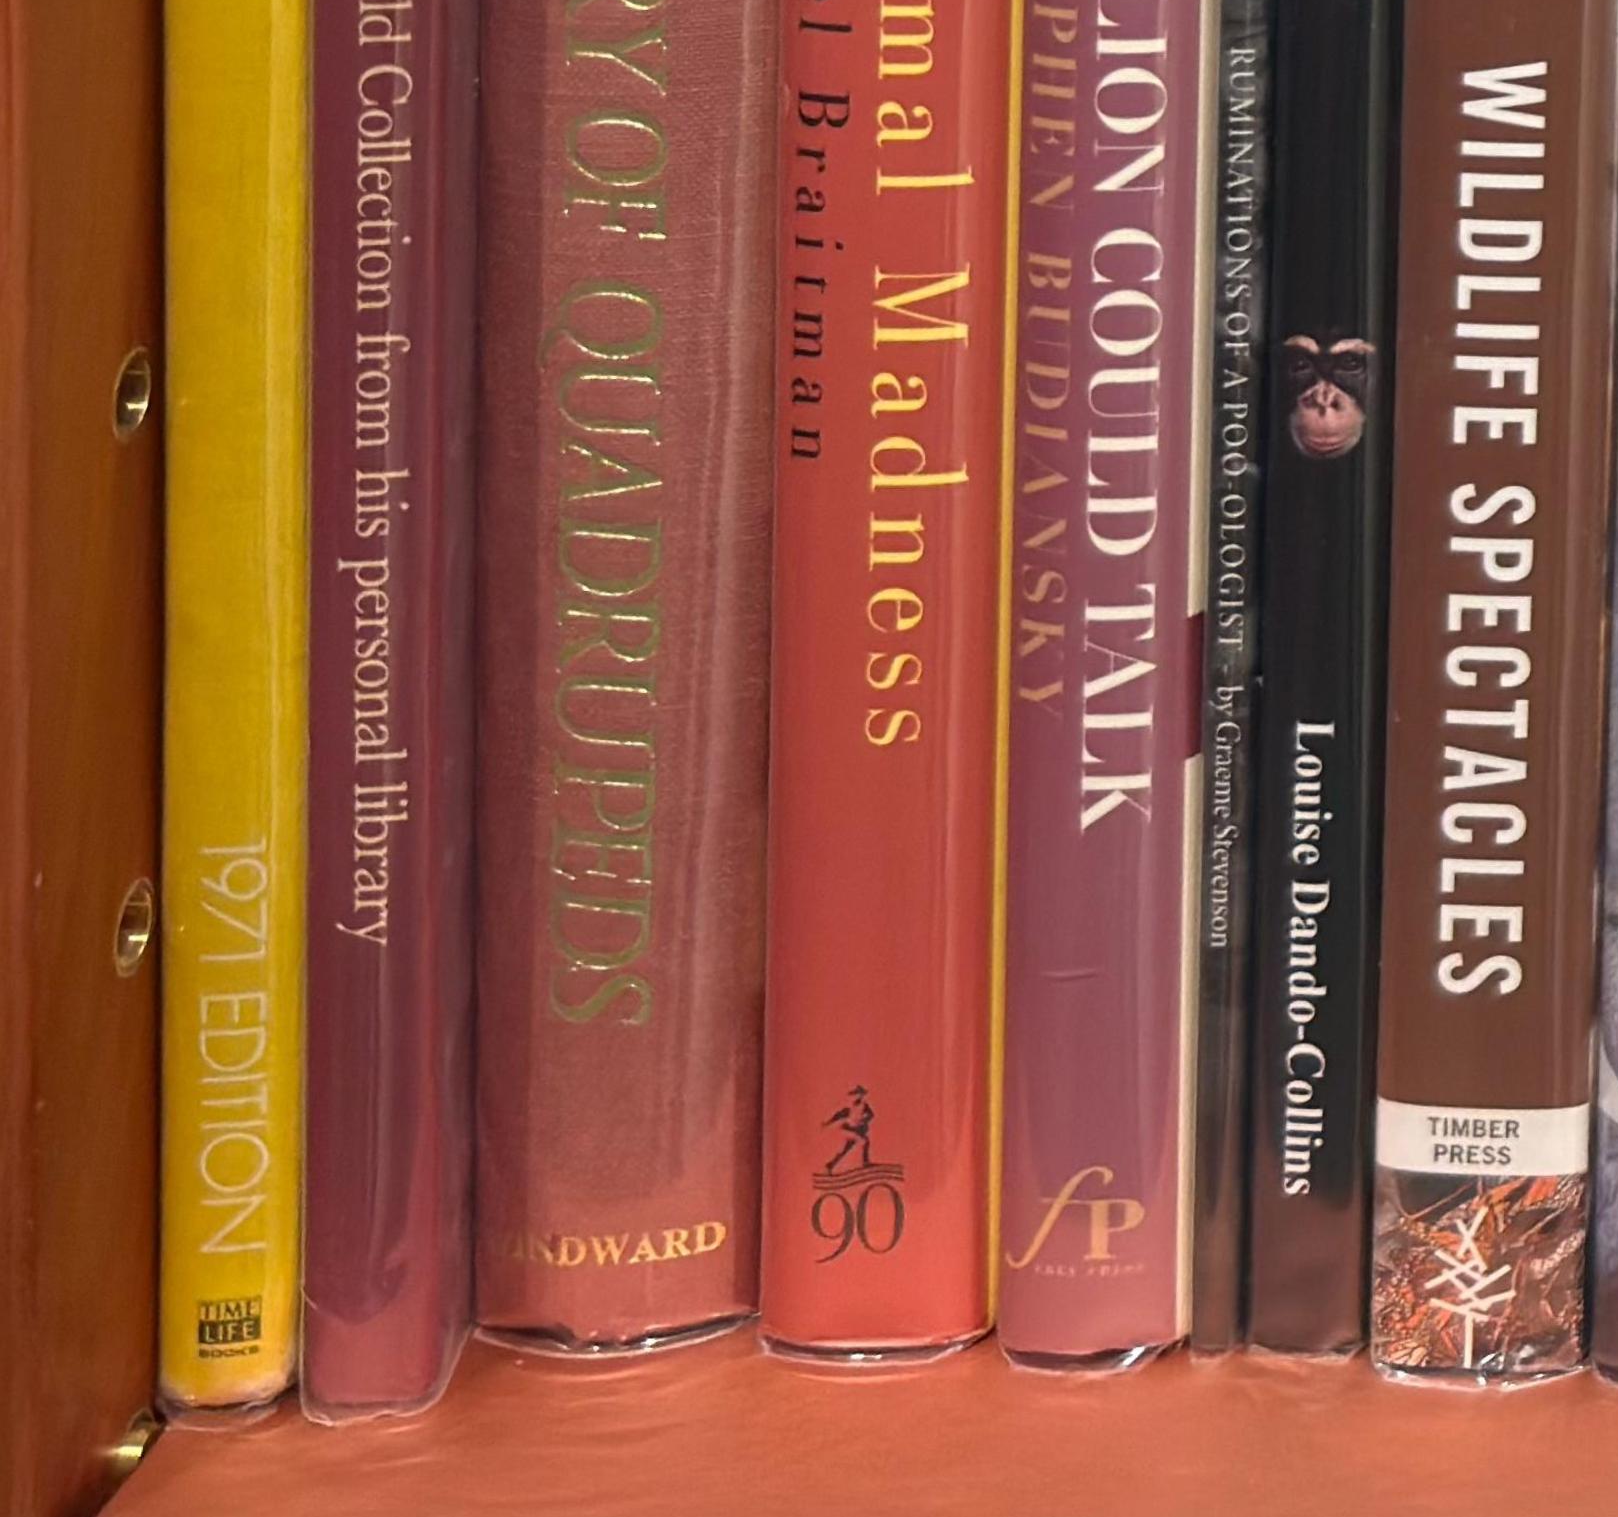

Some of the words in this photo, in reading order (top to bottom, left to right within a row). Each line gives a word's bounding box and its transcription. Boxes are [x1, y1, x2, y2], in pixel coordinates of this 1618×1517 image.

[355, 62, 413, 315] Collection
[564, 108, 669, 241] OF
[1223, 47, 1256, 305] RUMINATIONS
[1452, 61, 1548, 445] WILDLIFE
[791, 89, 851, 461] Braitman
[1222, 311, 1252, 357] OF
[355, 331, 411, 451] from
[1087, 227, 1164, 556] COULD
[1223, 368, 1250, 390] A
[354, 468, 410, 538] his
[865, 263, 970, 746] Madness
[1019, 252, 1072, 722] BUDIANSKY
[1217, 401, 1248, 651] POO-OLOGIST
[337, 559, 408, 763] personal
[539, 279, 665, 1028] QUADRUPEDS
[1080, 583, 1157, 836] TALK
[1209, 686, 1245, 714] by
[1213, 721, 1242, 820] Graeme
[1292, 721, 1335, 867] Louise
[1437, 483, 1538, 996] SPECTACLES
[201, 837, 268, 962] 1971
[336, 778, 408, 949] library
[1209, 825, 1239, 949] Stevenson
[1283, 881, 1331, 1196] Dando-Collins
[200, 992, 270, 1255] EDITION
[1427, 1116, 1520, 1139] TIMBER
[1433, 1144, 1512, 1165] PRESS
[811, 1183, 904, 1264] 90
[200, 1296, 262, 1320] TIME
[203, 1320, 256, 1343] LIFE
